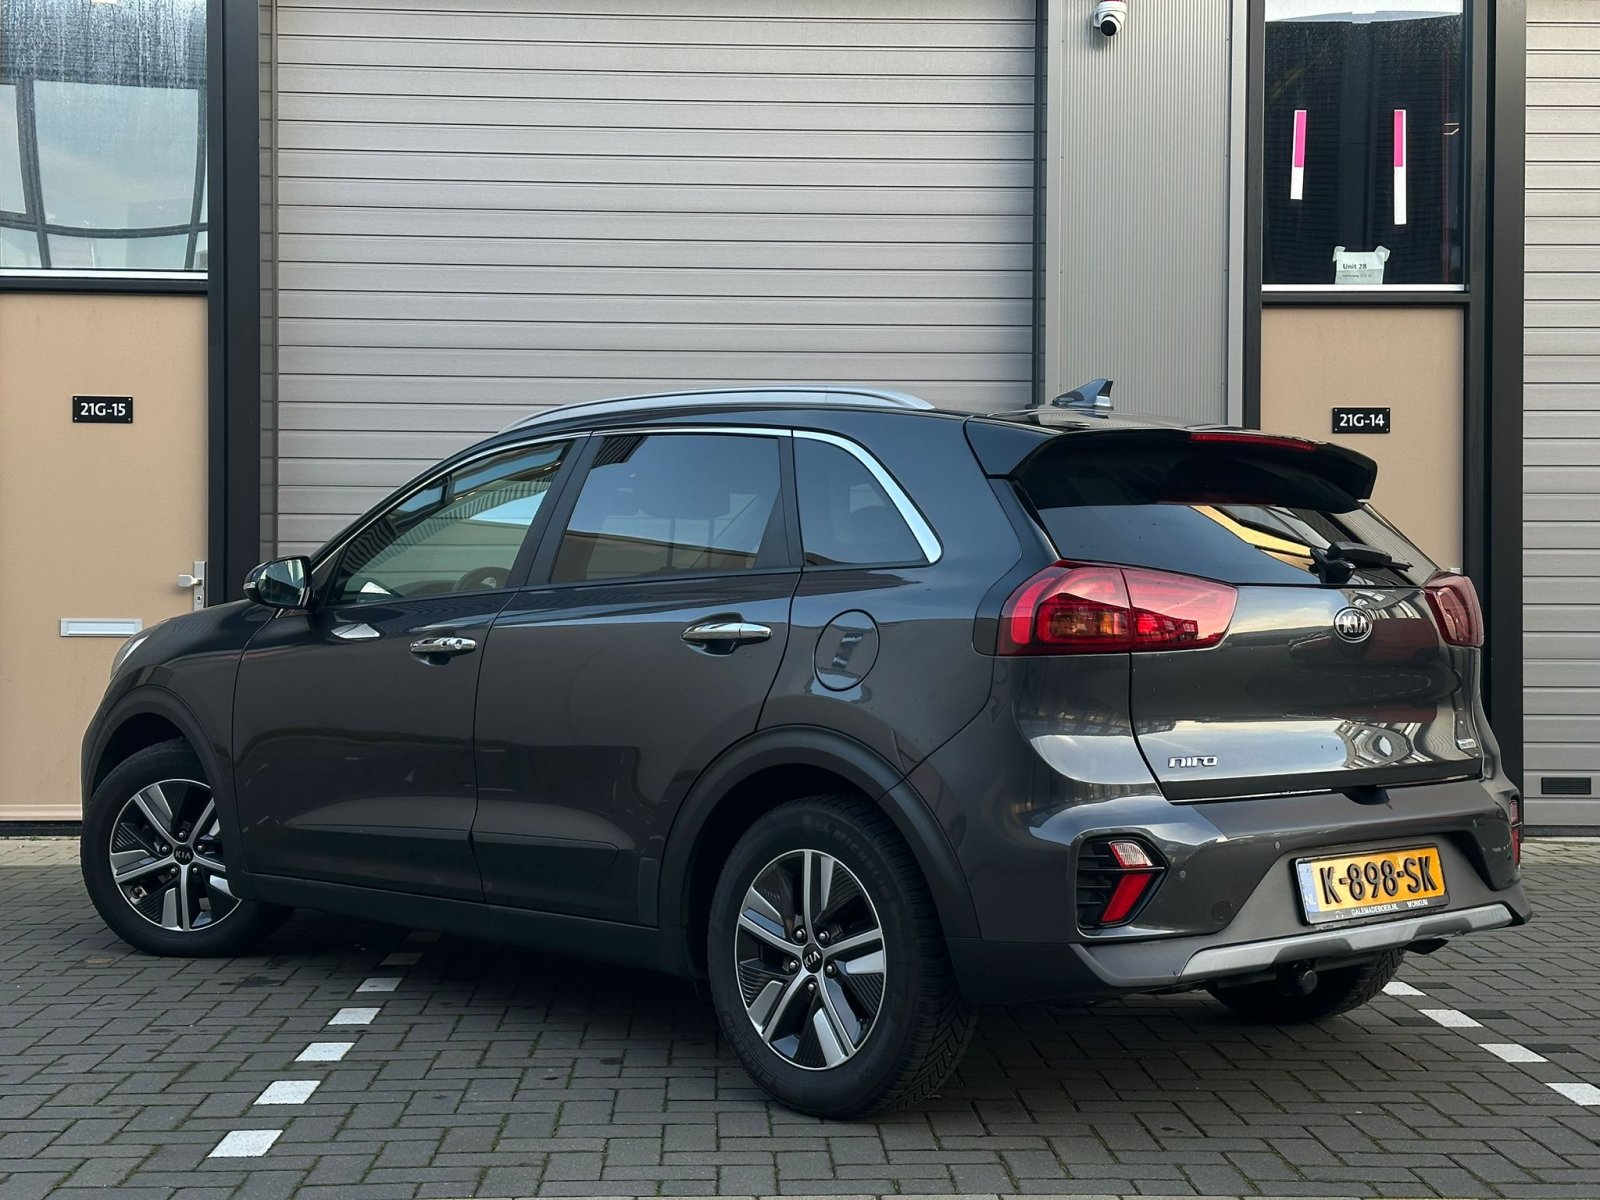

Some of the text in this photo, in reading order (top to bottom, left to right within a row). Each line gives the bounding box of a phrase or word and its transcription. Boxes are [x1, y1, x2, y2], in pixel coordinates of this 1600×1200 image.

[80, 402, 126, 417] 21G-15
[1339, 413, 1385, 427] 21G-14
[1342, 615, 1367, 633] KIA
[175, 850, 191, 860] KIA
[1319, 855, 1438, 905] K-898-SK
[1304, 893, 1317, 905] NL
[803, 950, 821, 968] KIA
